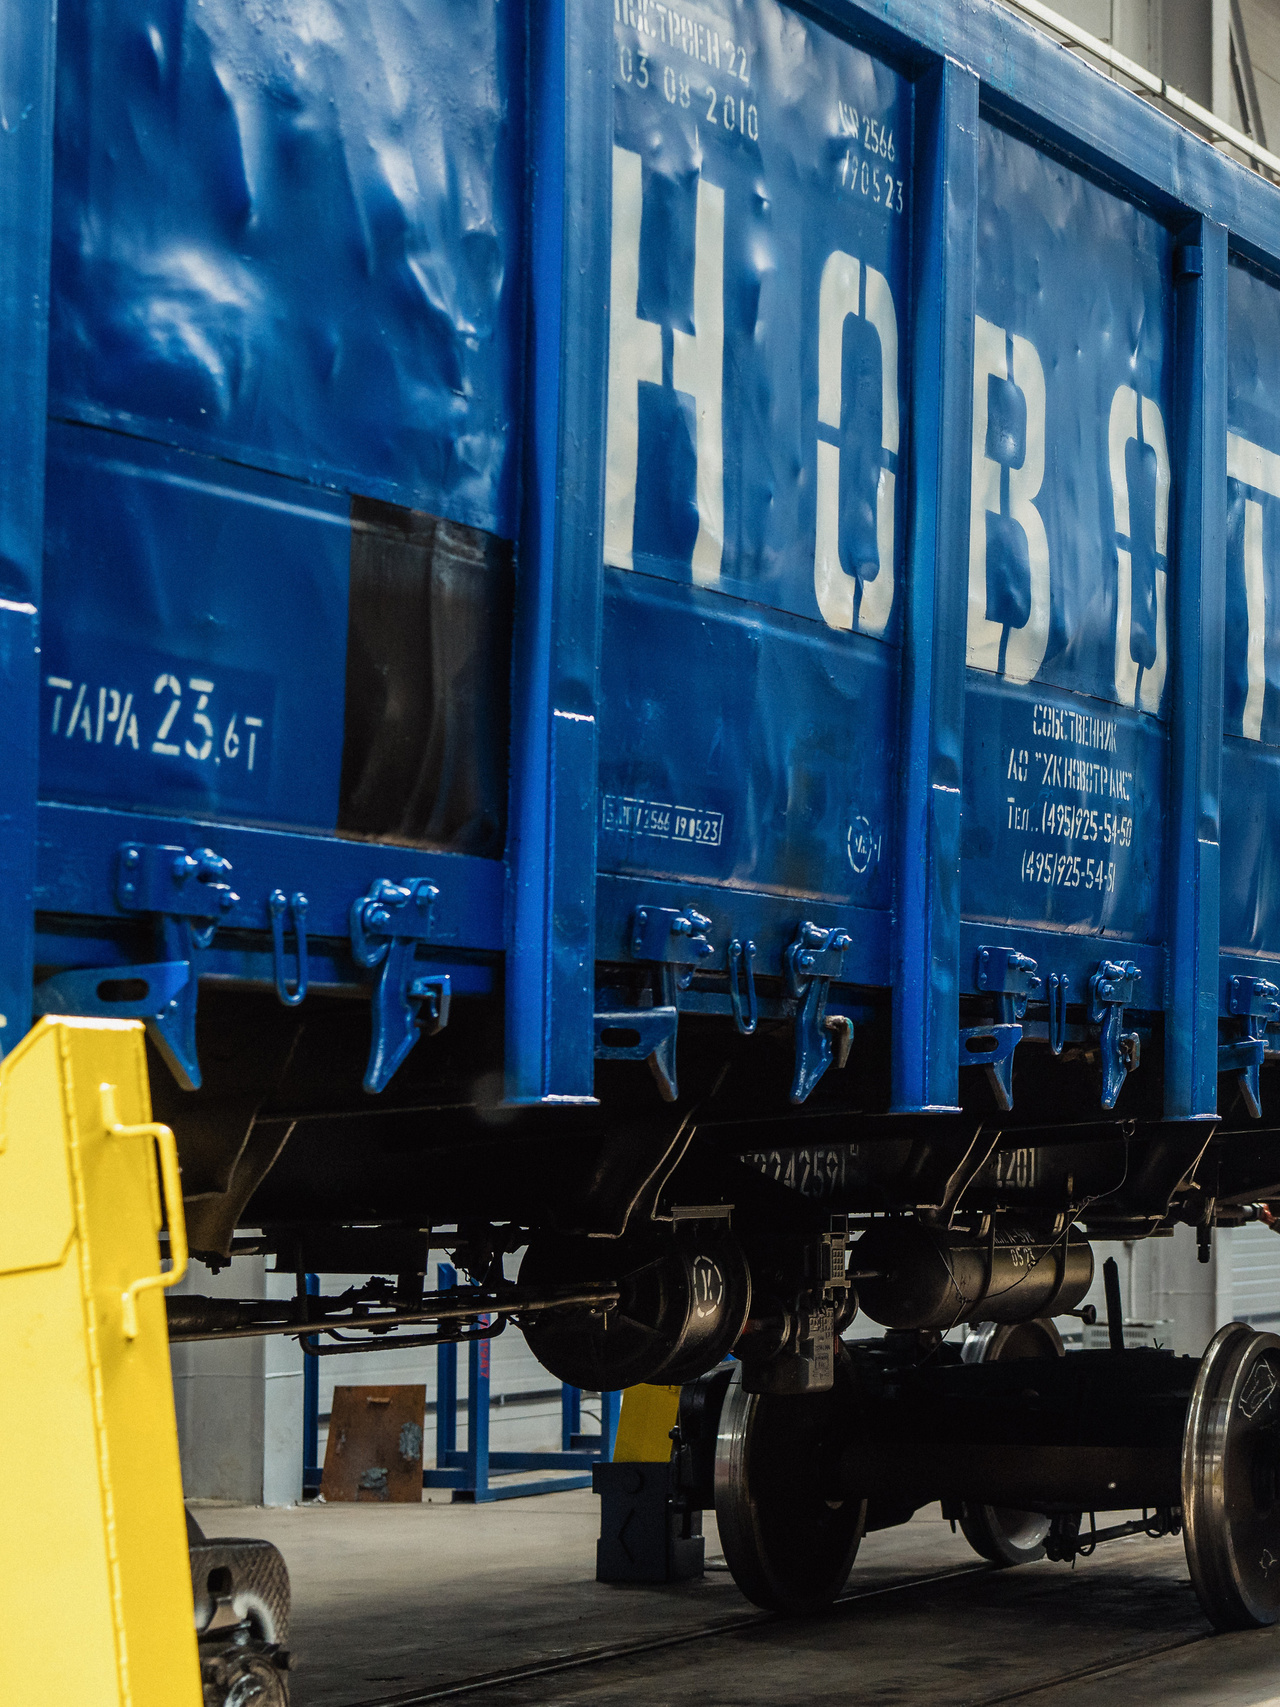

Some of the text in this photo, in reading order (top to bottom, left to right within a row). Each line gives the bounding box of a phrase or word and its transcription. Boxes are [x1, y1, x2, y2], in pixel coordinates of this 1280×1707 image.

[725, 38, 750, 84] 22
[619, 45, 759, 142] 03 08 2010
[862, 115, 896, 163] 2566
[842, 149, 904, 214] 190523
[46, 675, 139, 750] ТАРА
[1032, 703, 1117, 753] СОБСТВЕННИК
[1007, 747, 1029, 783] АО
[674, 814, 719, 842] 190523
[1041, 800, 1133, 848] (495)925-54-50
[1020, 848, 1117, 893] (495)925-54-51
